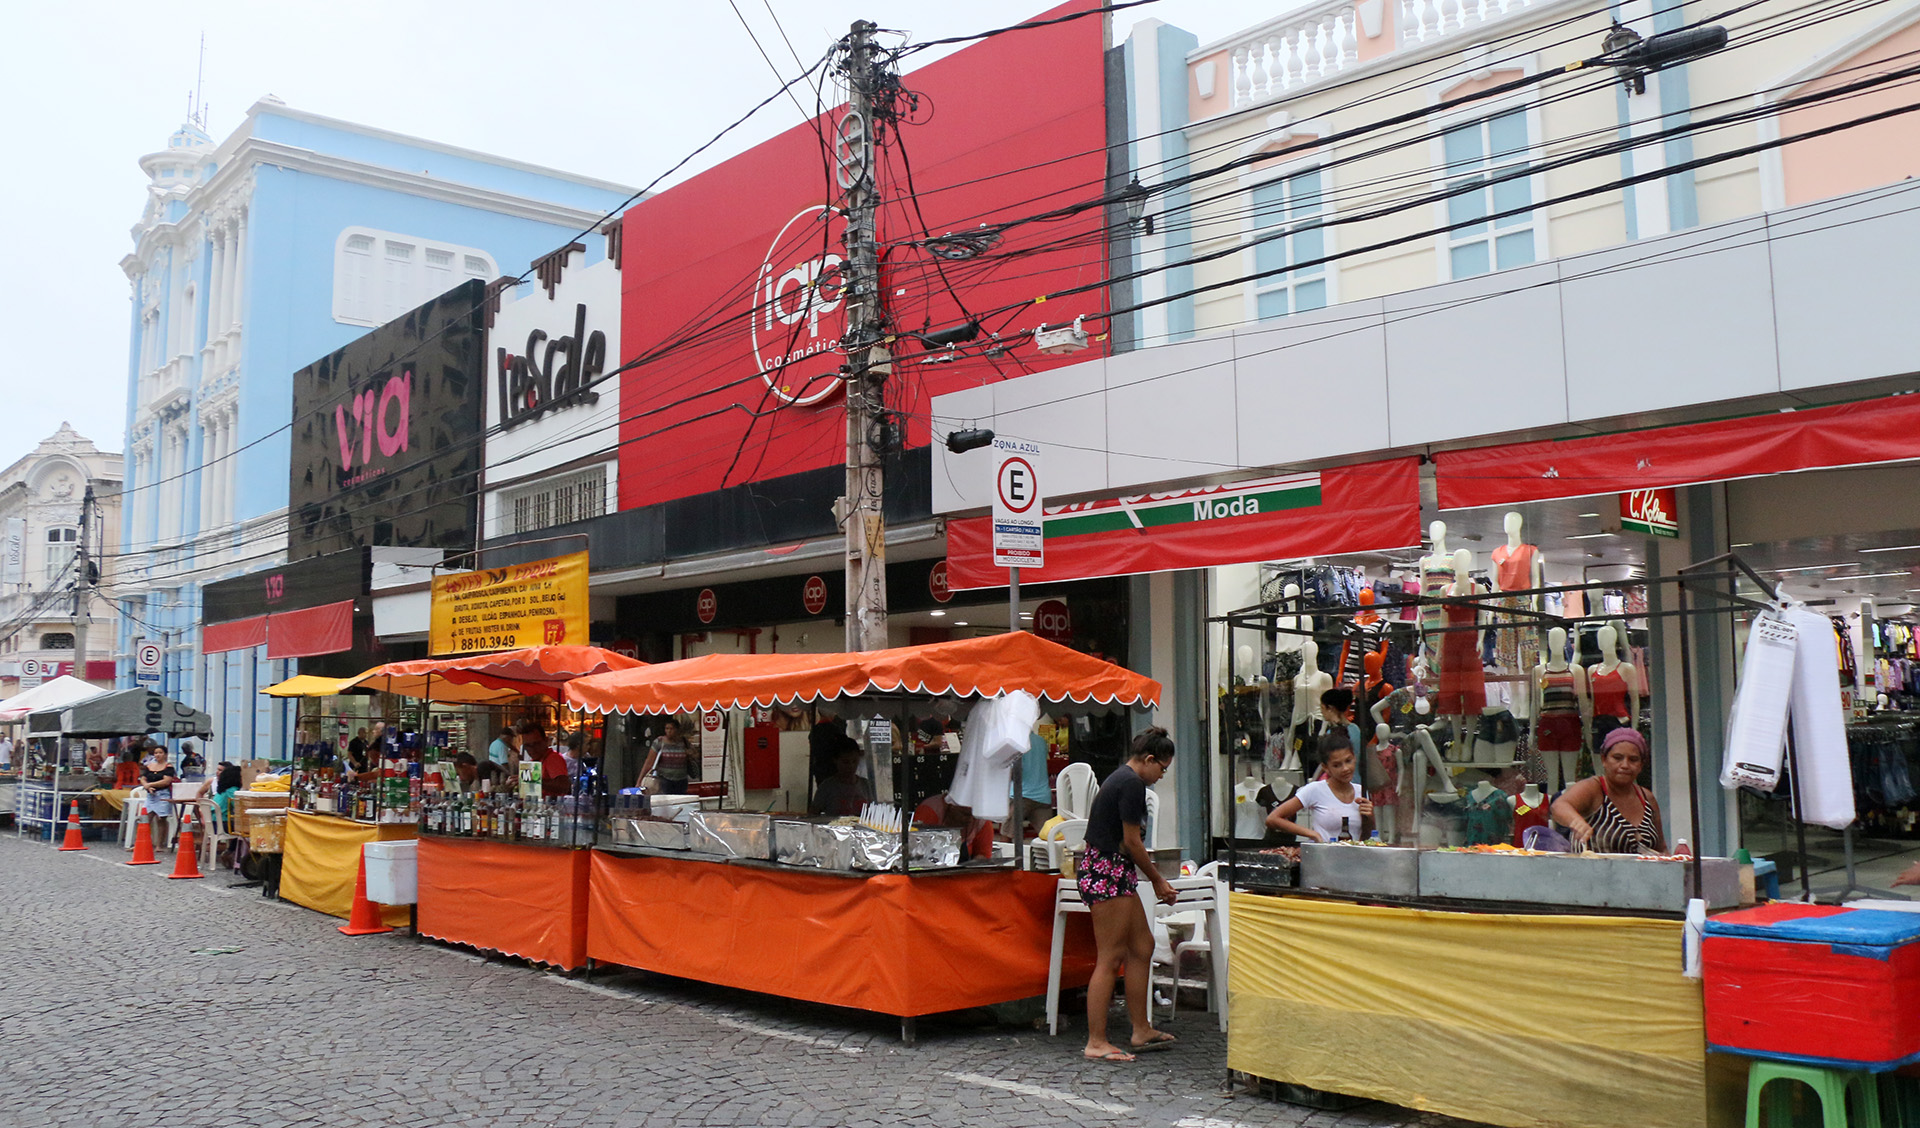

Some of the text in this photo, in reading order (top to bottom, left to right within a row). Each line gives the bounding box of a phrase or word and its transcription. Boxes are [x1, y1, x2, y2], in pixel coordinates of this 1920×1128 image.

[765, 338, 845, 370] cosmétic
[336, 370, 410, 472] via
[994, 440, 1017, 450] ZONA
[1019, 443, 1040, 453] AZUL
[1010, 469, 1025, 500] E
[1193, 495, 1260, 521] Moda
[1039, 608, 1070, 637] iap!
[146, 650, 153, 661] E
[461, 635, 515, 650] 8810.3949
[28, 663, 34, 672] E
